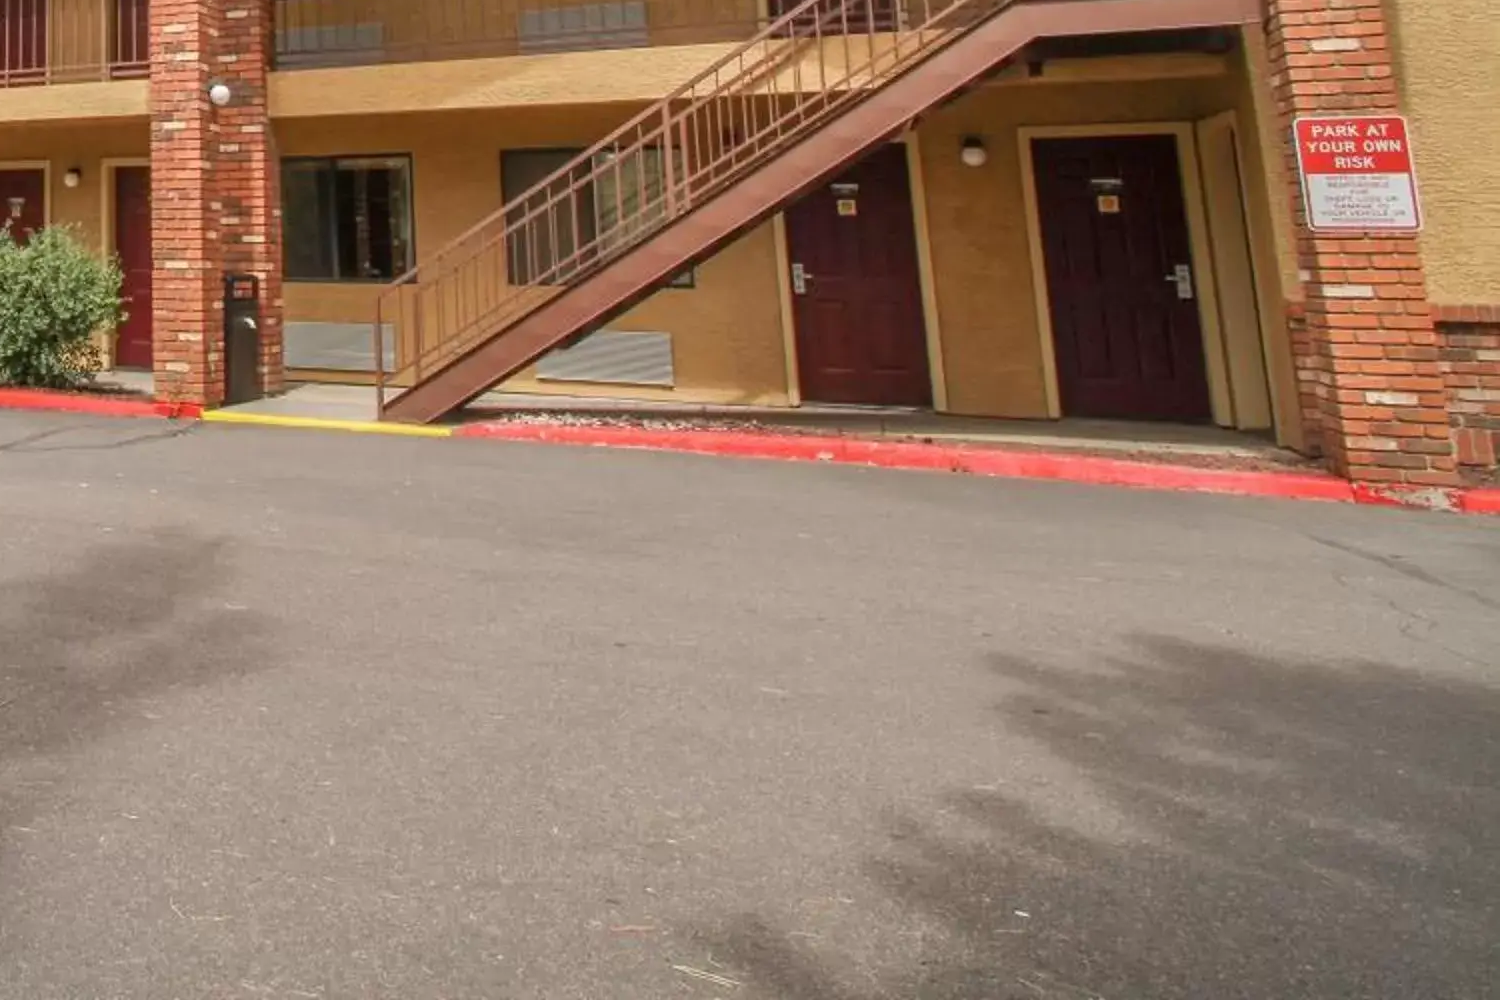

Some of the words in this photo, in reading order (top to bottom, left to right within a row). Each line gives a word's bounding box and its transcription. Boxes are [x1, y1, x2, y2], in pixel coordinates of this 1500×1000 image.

[1311, 124, 1359, 137] PARK
[1367, 123, 1389, 136] AT
[1305, 141, 1356, 153] YOUR
[1363, 140, 1401, 152] OWN
[1334, 156, 1376, 169] RISK
